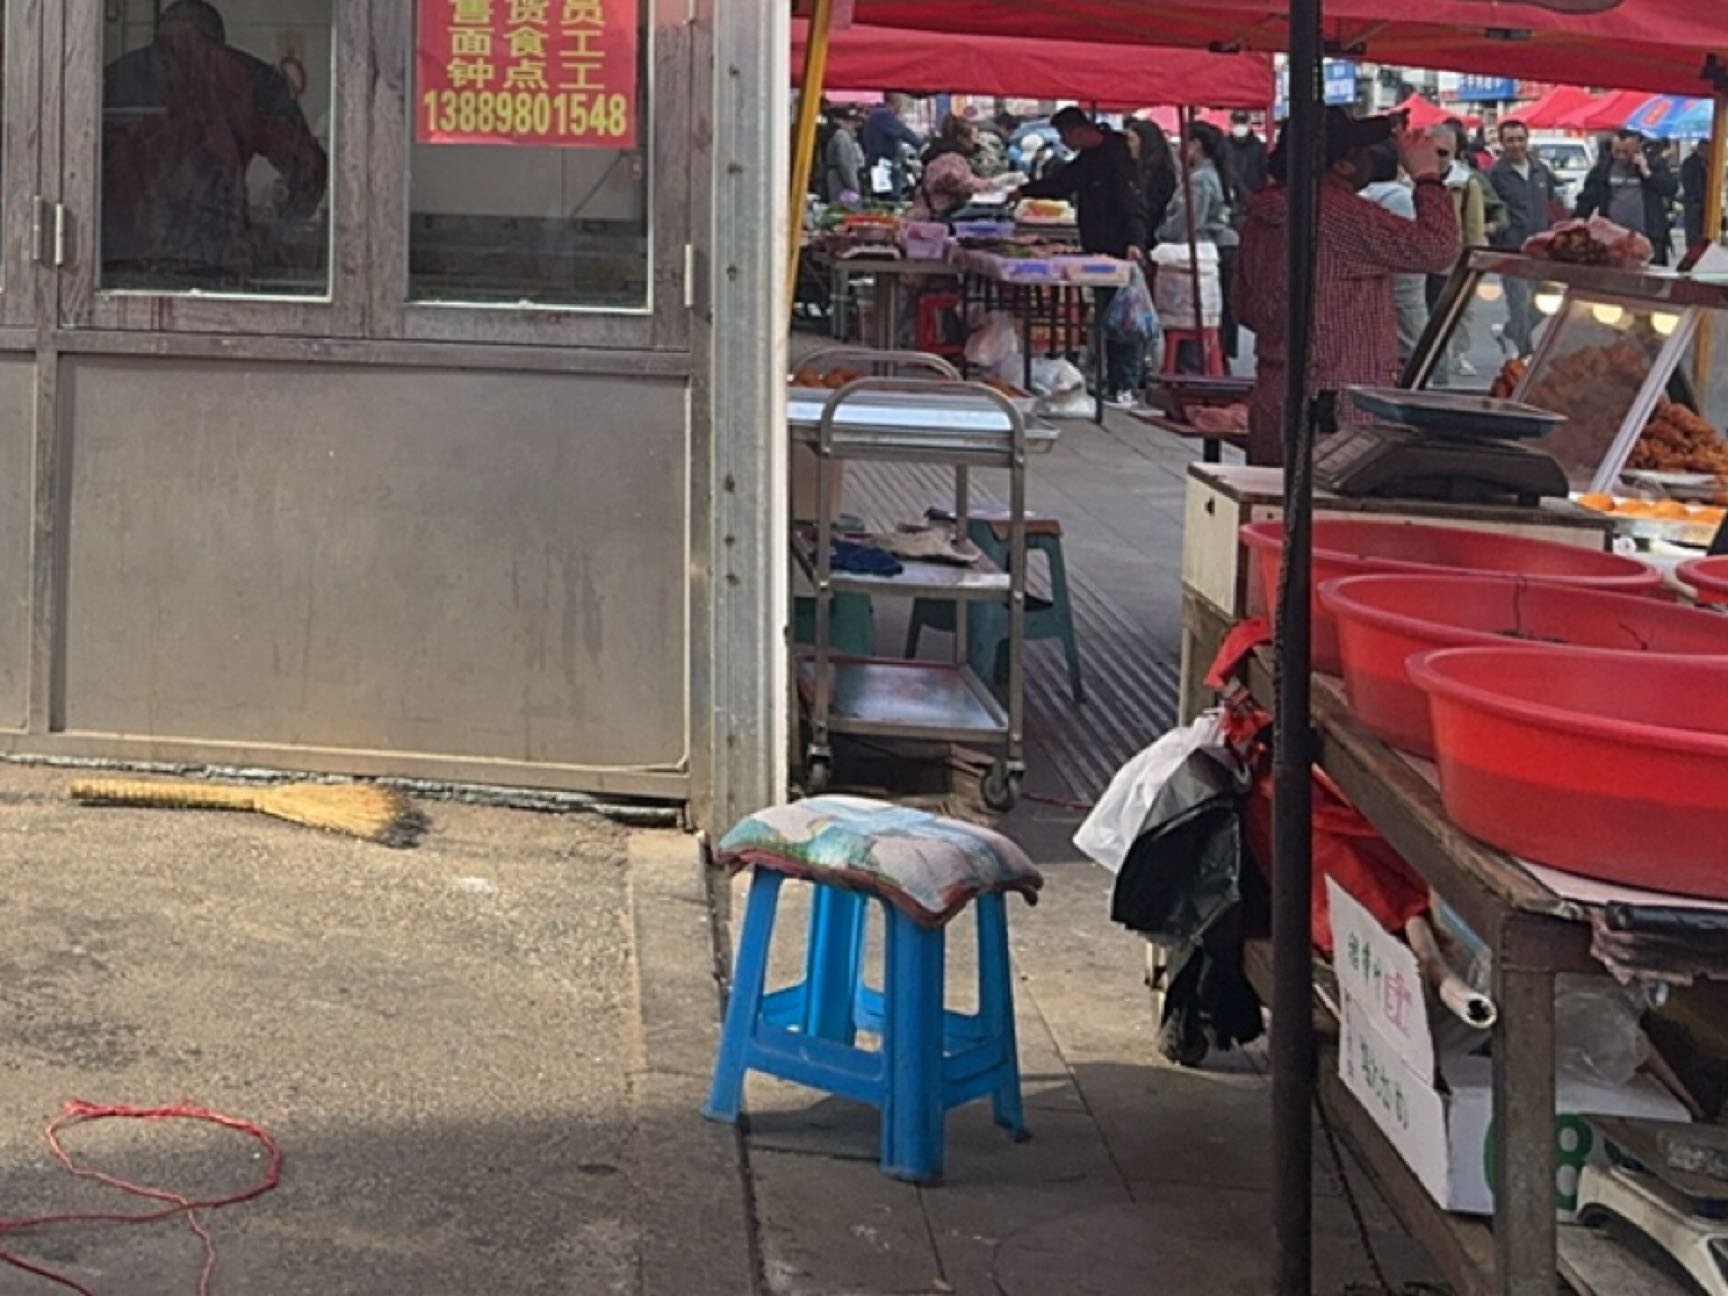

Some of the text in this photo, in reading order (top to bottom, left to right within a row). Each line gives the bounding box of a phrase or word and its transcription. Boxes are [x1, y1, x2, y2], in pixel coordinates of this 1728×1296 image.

[447, 26, 606, 58] 面食工
[445, 58, 606, 90] 钟点工
[423, 89, 628, 137] 13889801548
